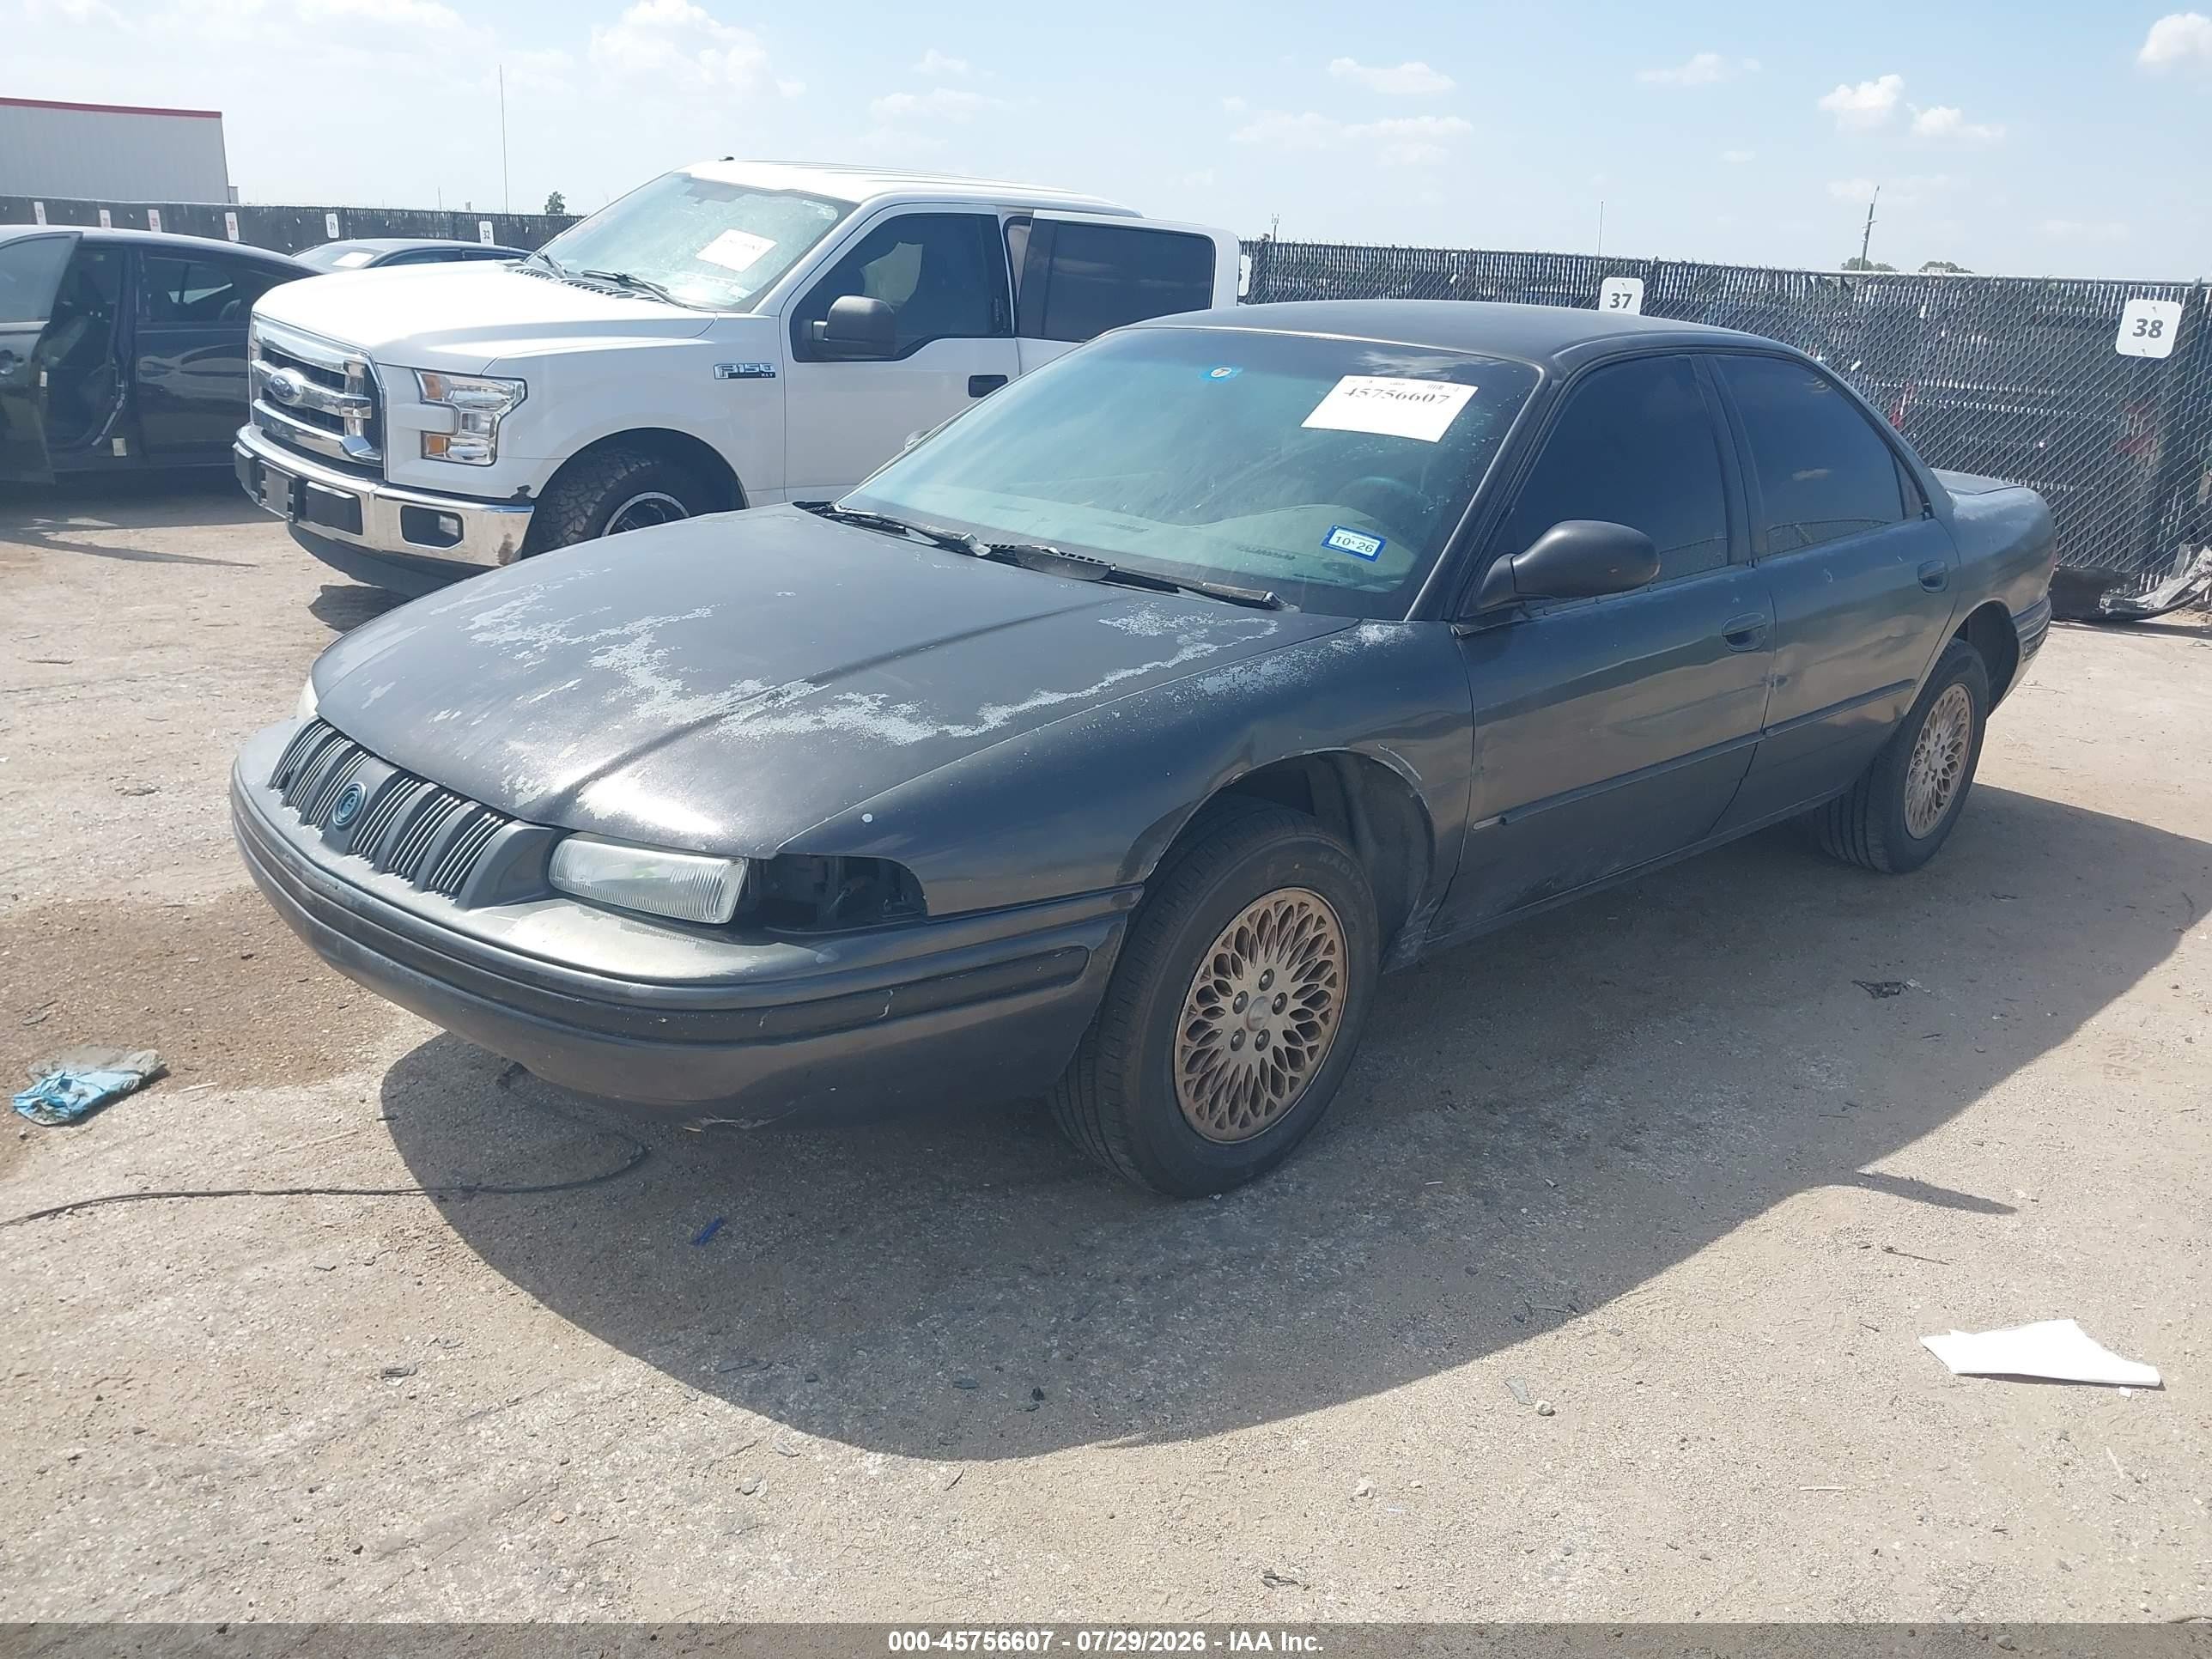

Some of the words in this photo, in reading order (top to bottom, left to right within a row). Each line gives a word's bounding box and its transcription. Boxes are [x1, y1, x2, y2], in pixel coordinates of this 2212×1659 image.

[329, 221, 336, 231] 31
[483, 229, 490, 240] 32
[1609, 292, 1632, 309] 37
[2132, 318, 2164, 338] 38
[1343, 387, 1450, 405] 45756607
